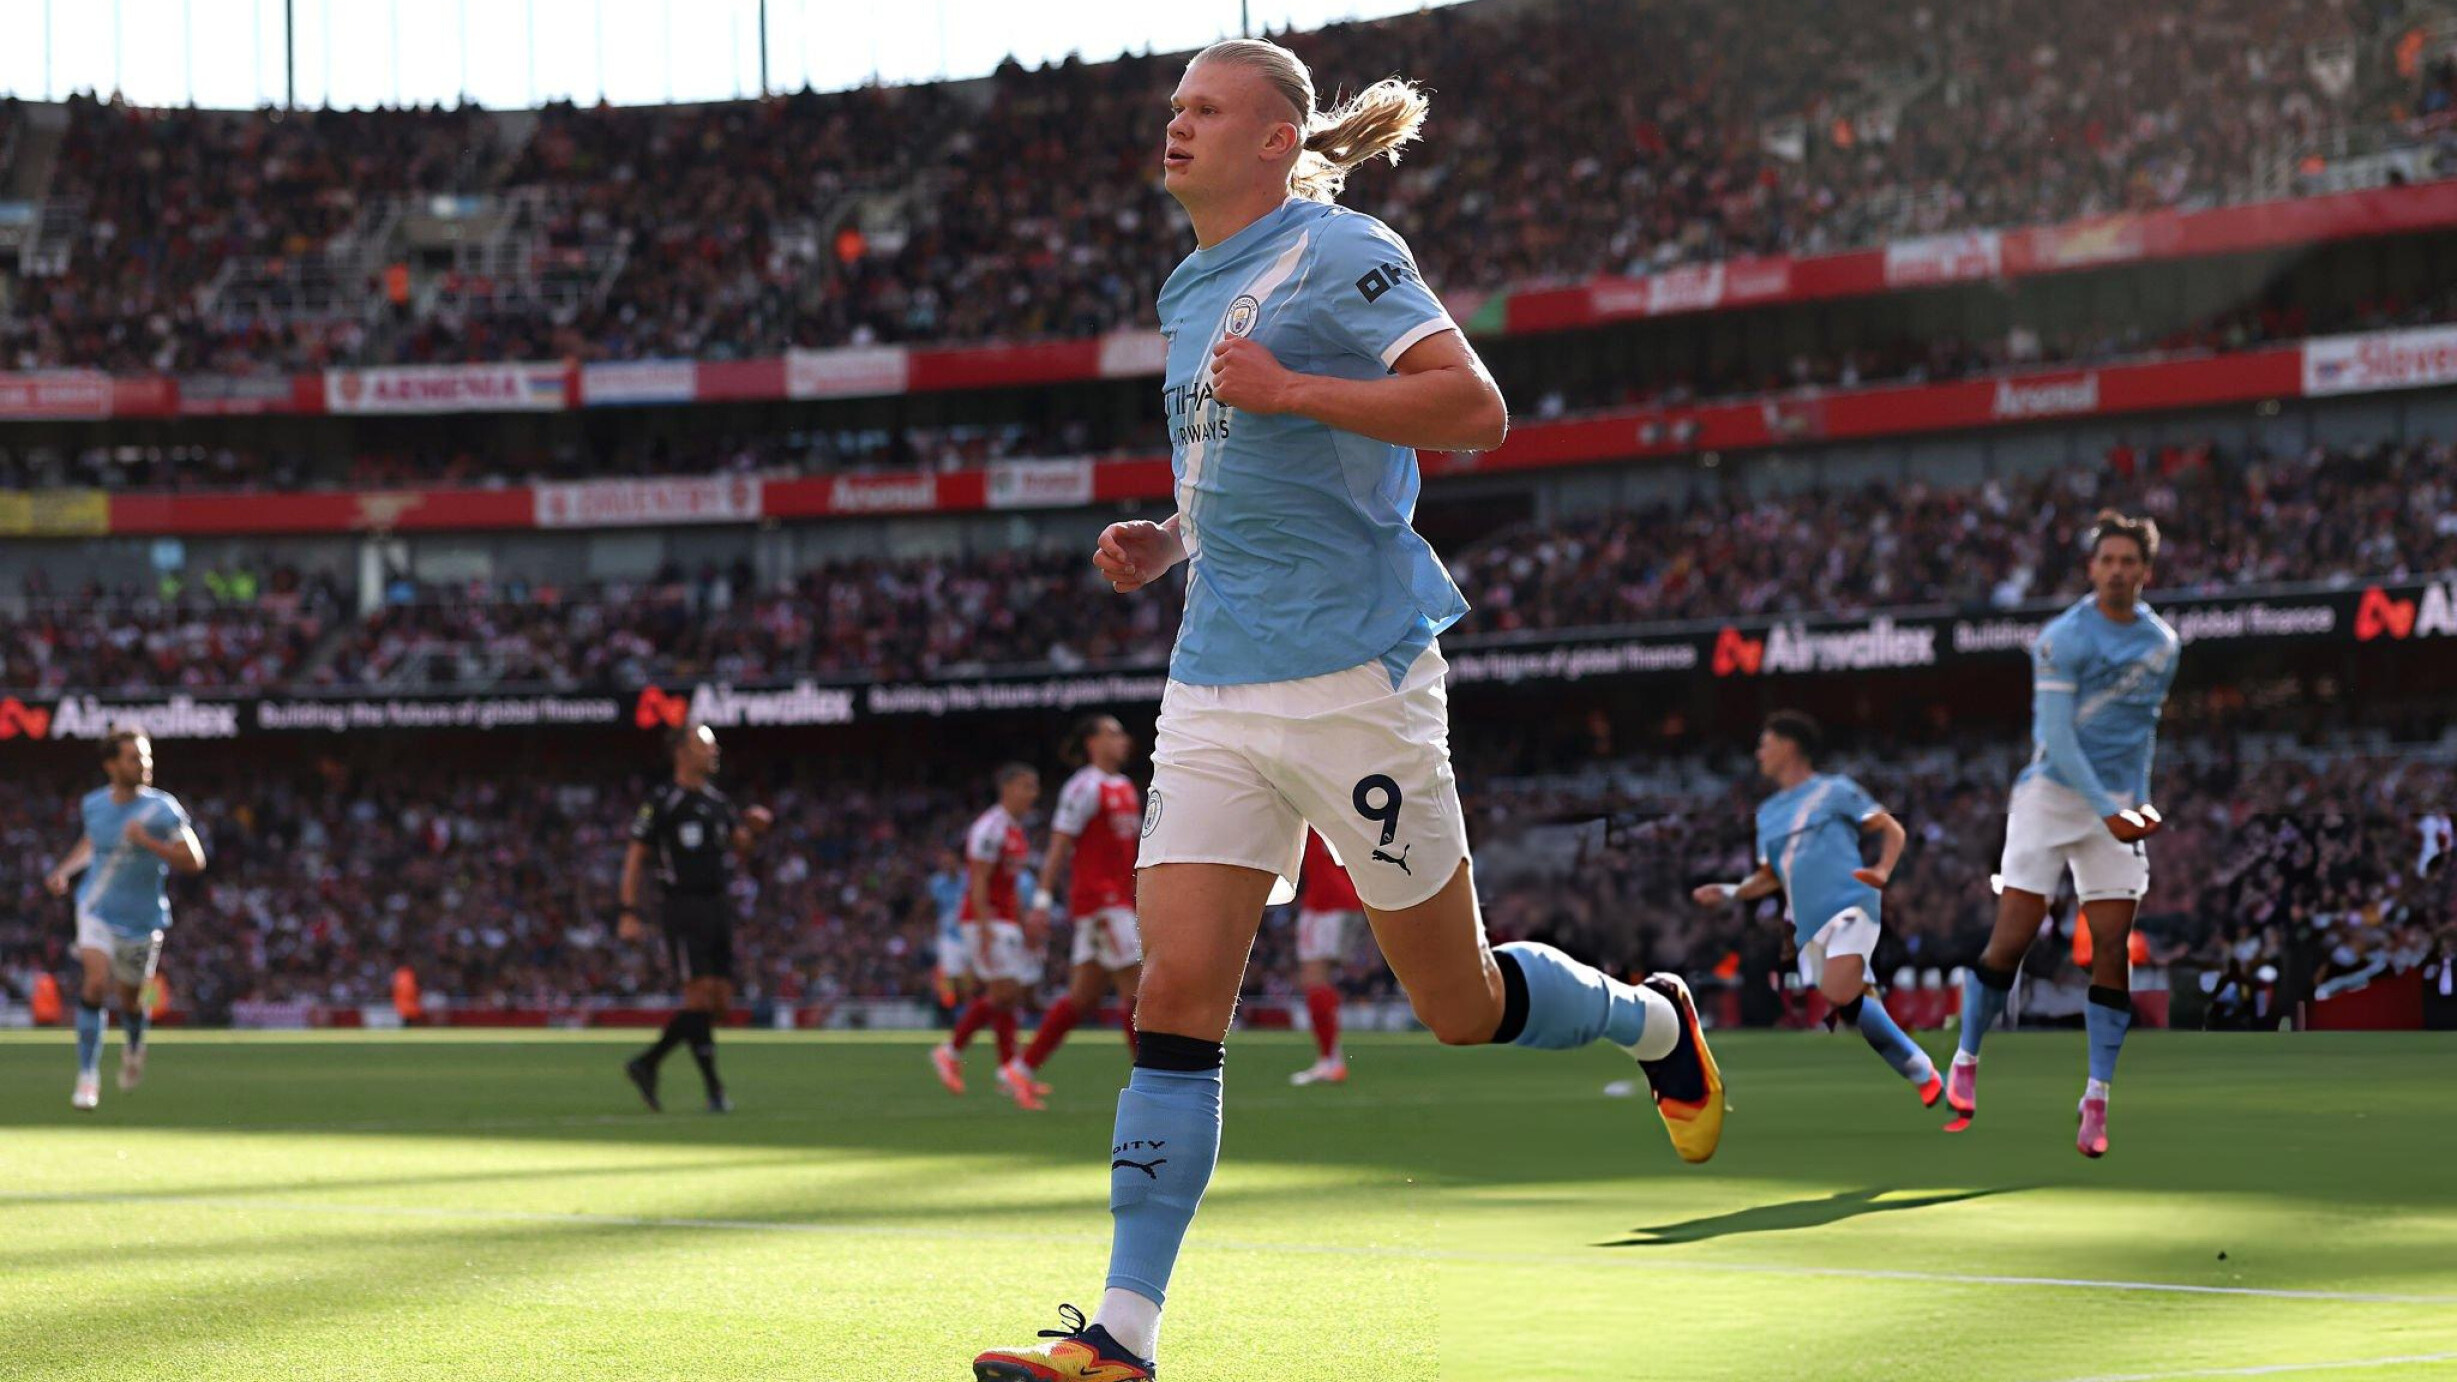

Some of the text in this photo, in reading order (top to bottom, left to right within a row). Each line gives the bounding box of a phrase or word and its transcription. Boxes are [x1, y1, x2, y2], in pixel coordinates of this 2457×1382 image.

[1762, 615, 1936, 673] Airwallex
[52, 694, 238, 740] Airwallex
[258, 702, 347, 732] Building
[351, 702, 385, 726] the
[539, 697, 620, 722] finance
[689, 681, 853, 726] Airwallex
[1353, 774, 1402, 846] 9
